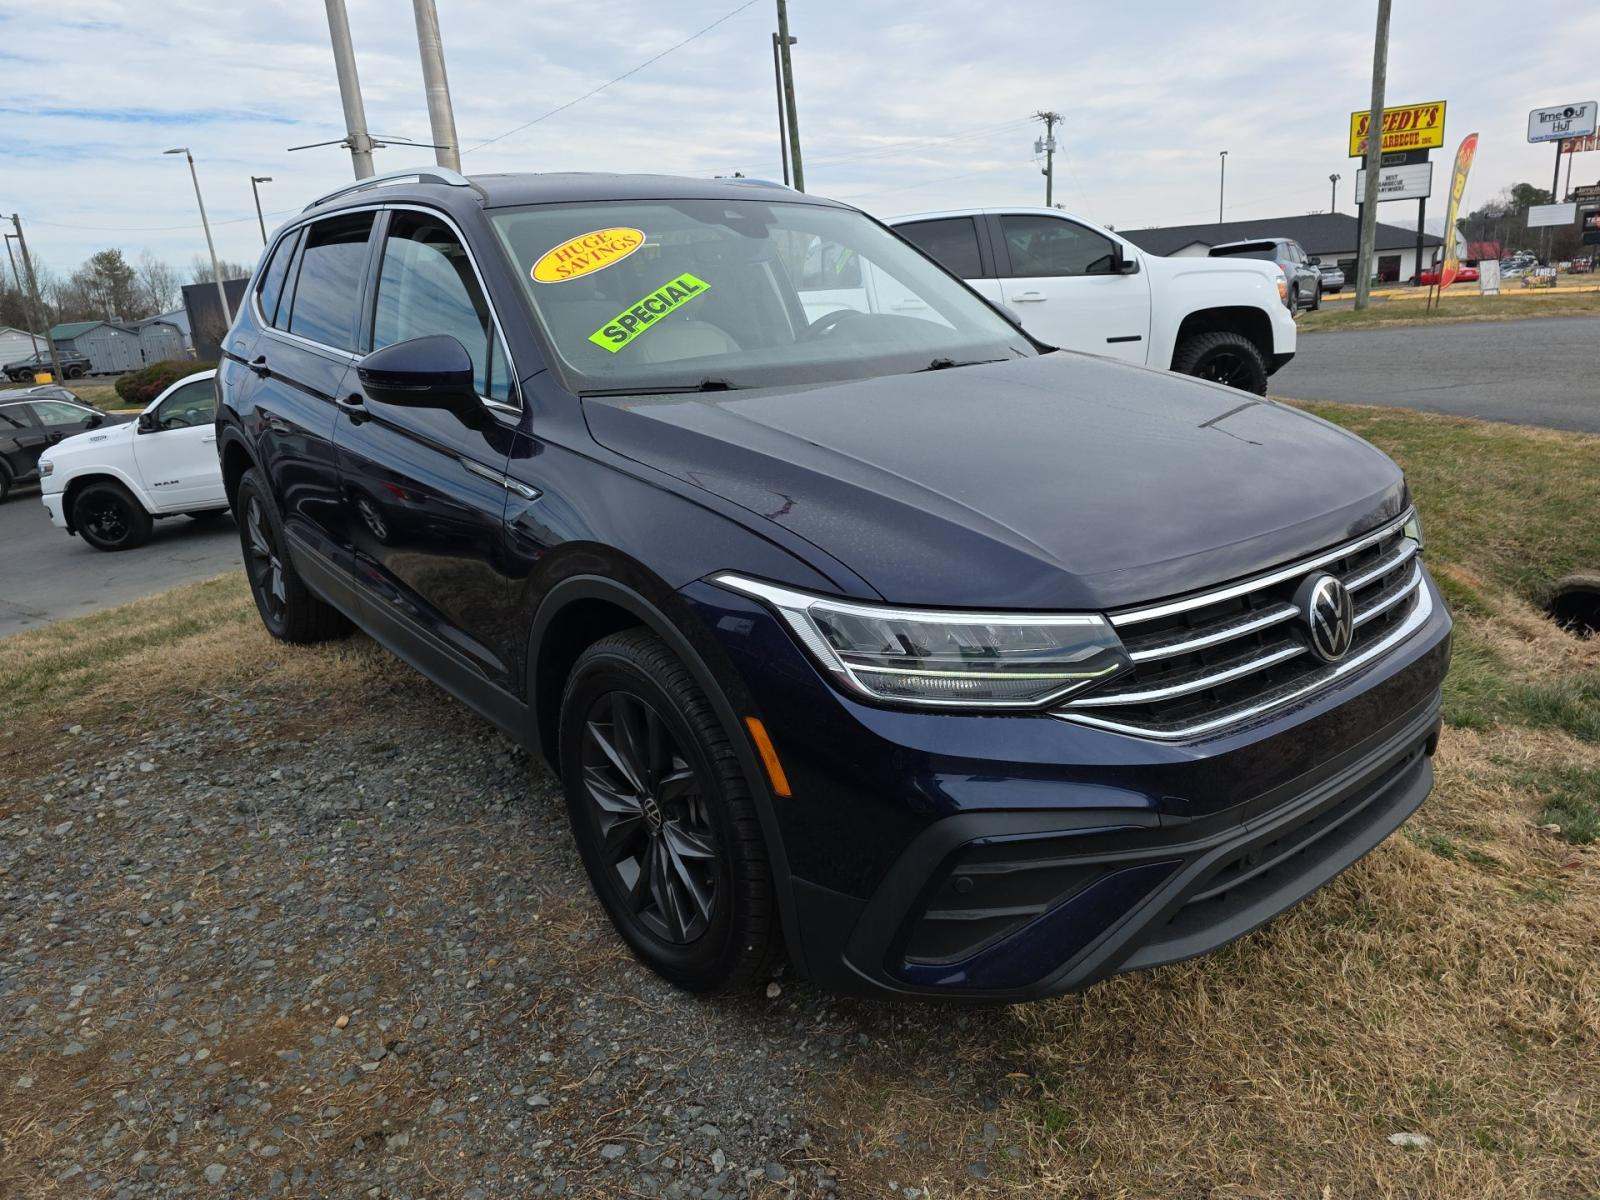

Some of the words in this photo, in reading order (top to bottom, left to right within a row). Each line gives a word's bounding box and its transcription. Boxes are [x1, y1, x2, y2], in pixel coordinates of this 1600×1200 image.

[1357, 106, 1439, 136] SEEDY'S
[1382, 132, 1420, 148] ARBECUE
[554, 232, 612, 264] HUGE
[556, 235, 638, 278] SAVINGS
[603, 280, 700, 343] SPECIAL
